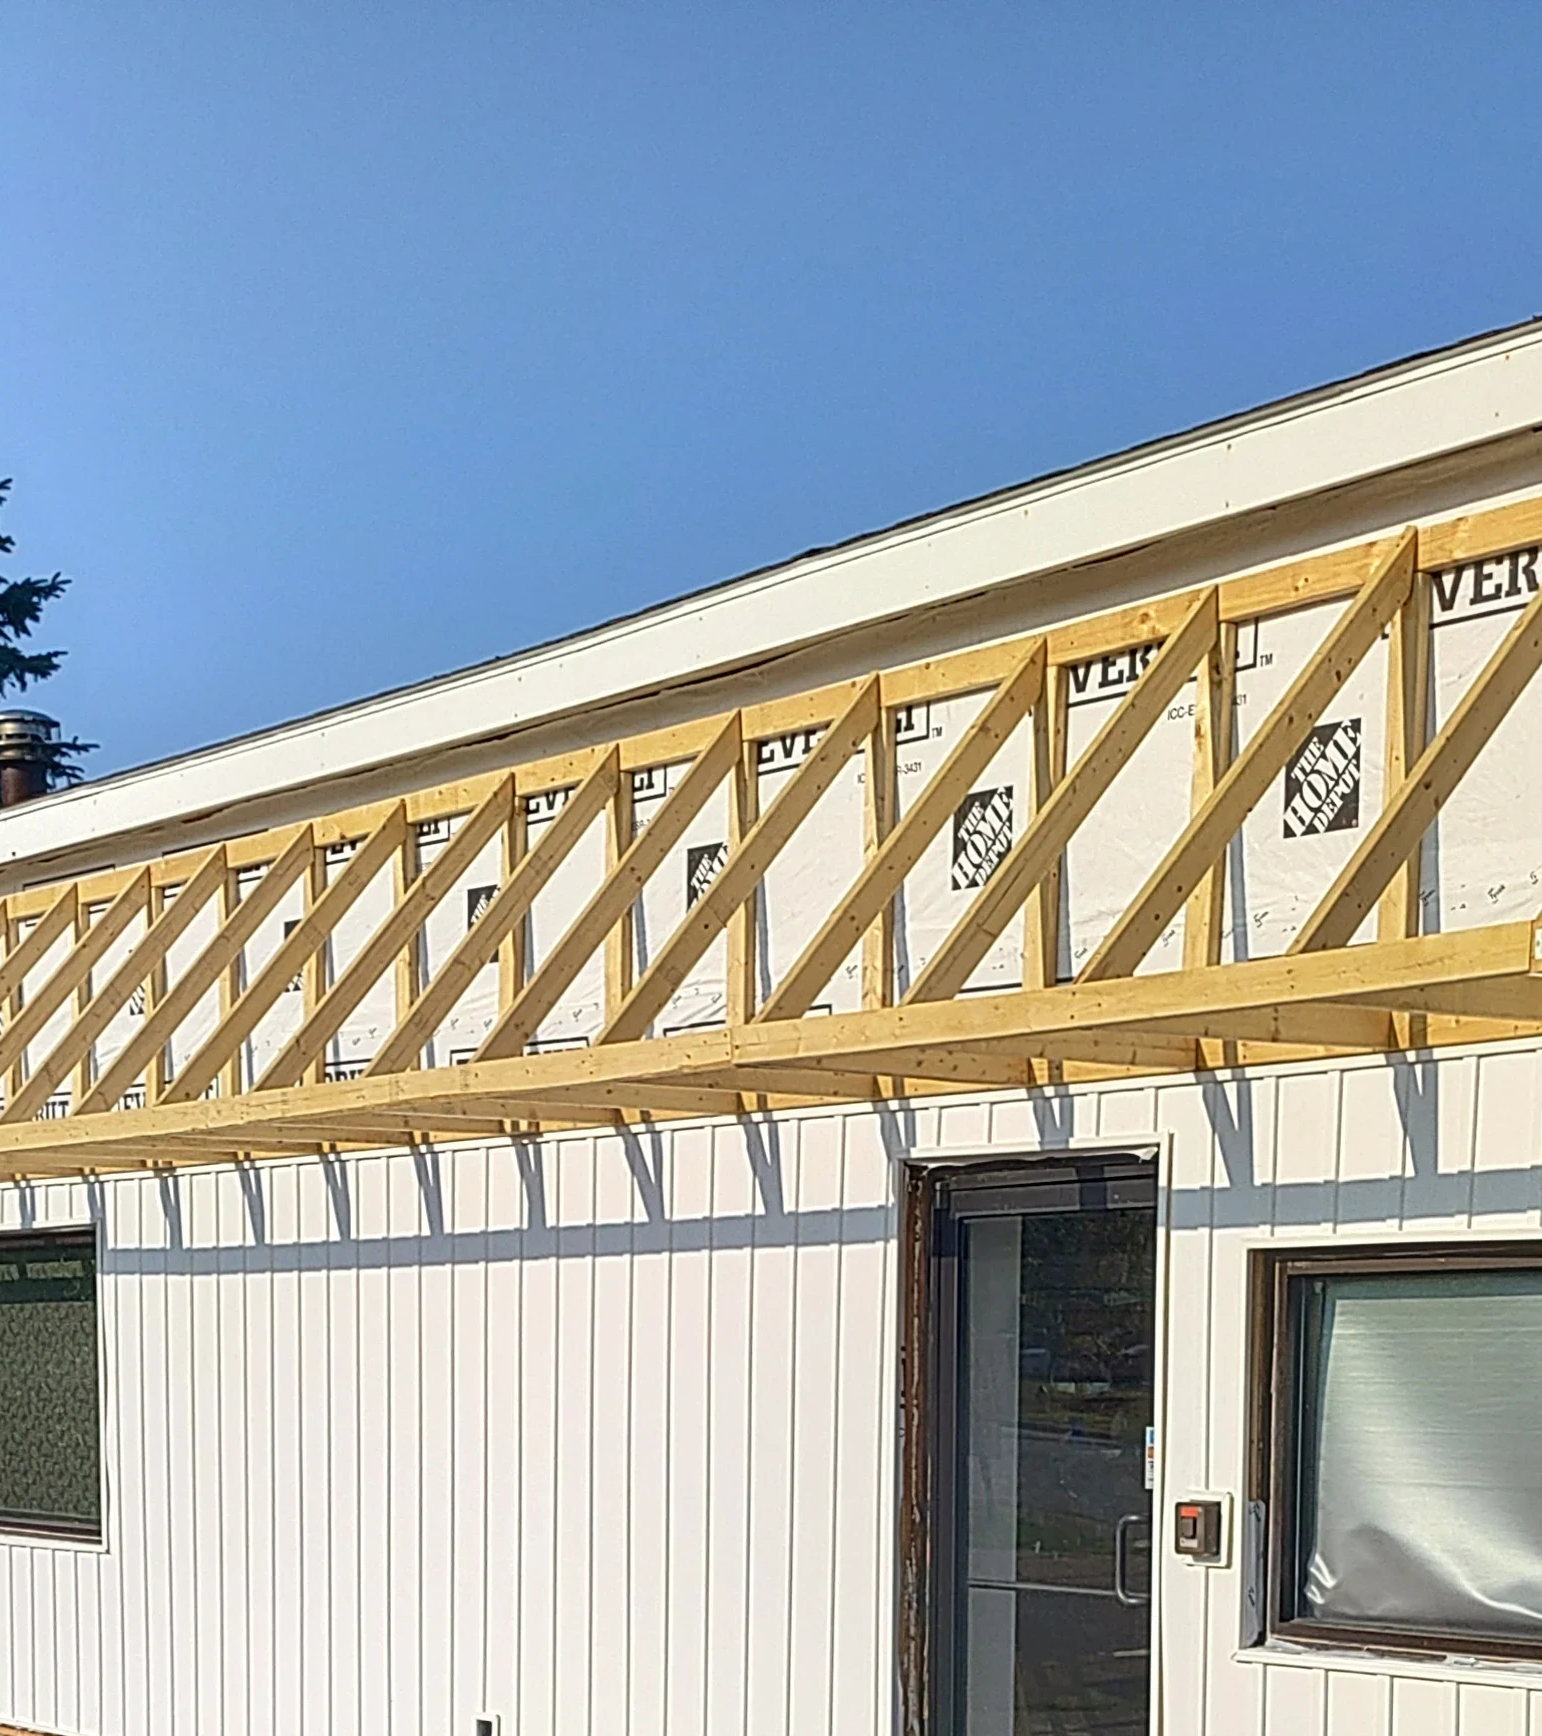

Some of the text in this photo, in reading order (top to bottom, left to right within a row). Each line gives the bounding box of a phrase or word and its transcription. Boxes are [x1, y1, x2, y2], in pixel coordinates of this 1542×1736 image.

[1167, 704, 1197, 721] ICC-E
[1283, 719, 1361, 837] HOME
[1290, 736, 1324, 784] THE
[957, 800, 985, 842] THE
[1312, 754, 1360, 834] DEPOT
[952, 786, 1013, 890] HOME
